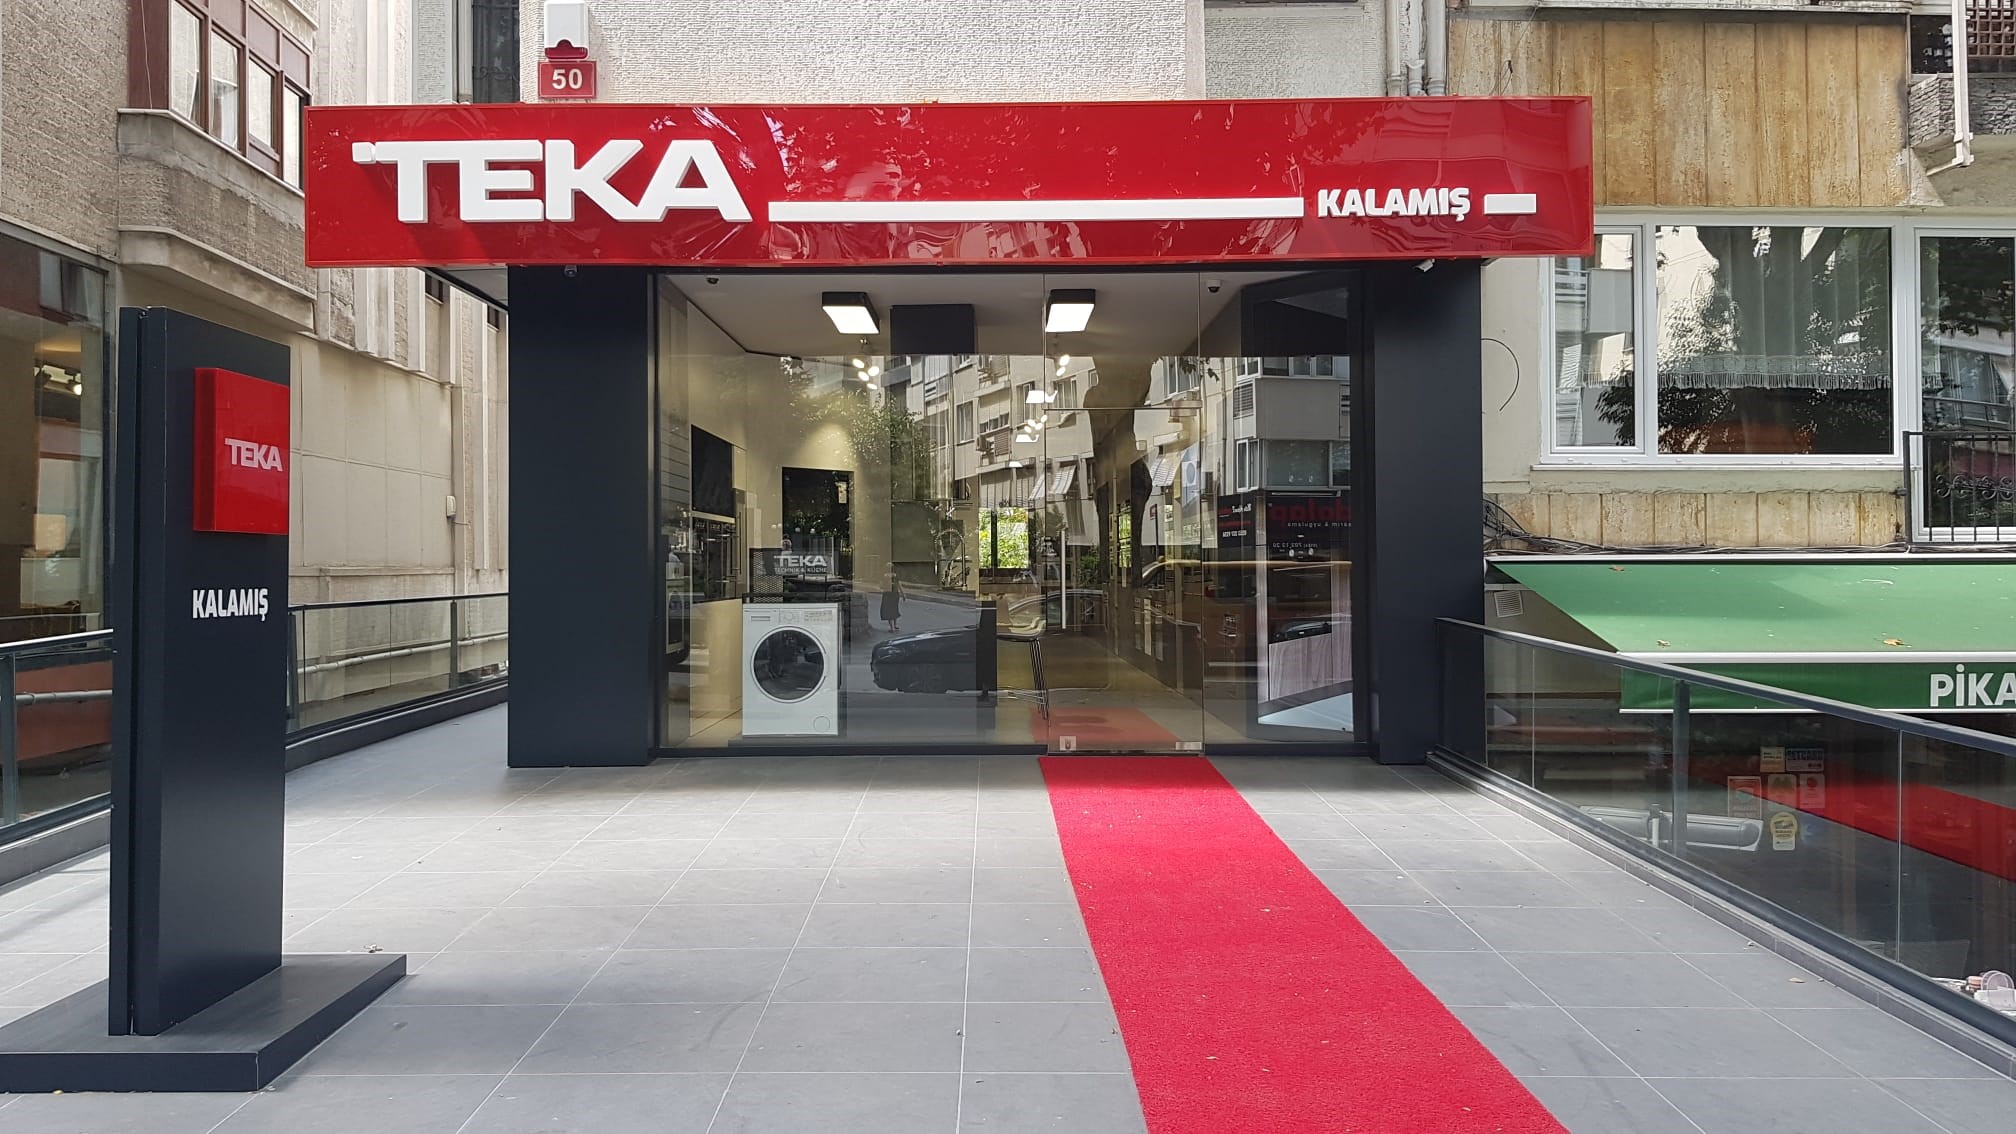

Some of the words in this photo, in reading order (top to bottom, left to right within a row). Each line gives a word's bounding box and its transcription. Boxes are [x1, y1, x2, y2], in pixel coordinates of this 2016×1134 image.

[552, 69, 583, 90] 50
[352, 139, 754, 223] TEKA
[1318, 187, 1471, 221] KALAMIŞ
[224, 437, 283, 472] TEKA
[773, 555, 827, 567] TEKA
[192, 588, 269, 621] KALAMIŞ
[1930, 663, 2016, 707] PİKA
